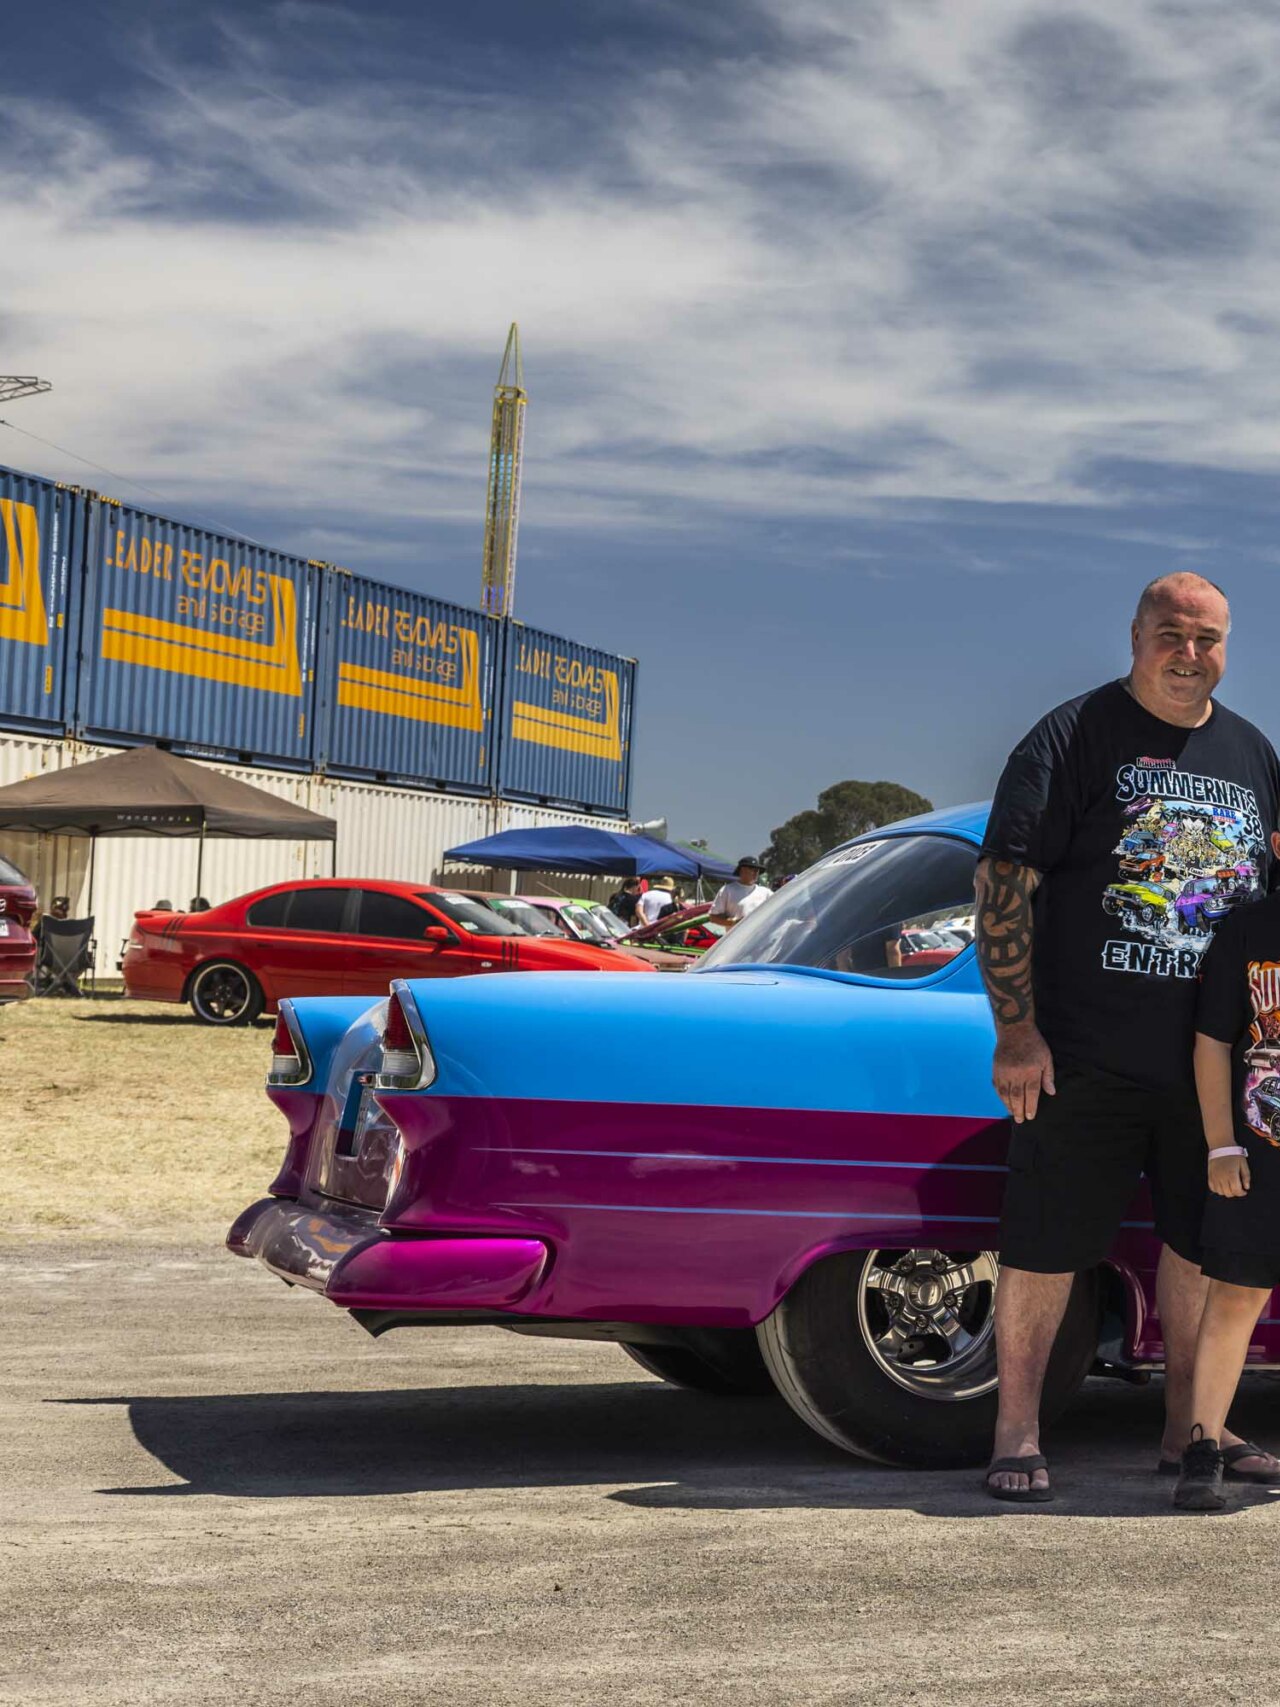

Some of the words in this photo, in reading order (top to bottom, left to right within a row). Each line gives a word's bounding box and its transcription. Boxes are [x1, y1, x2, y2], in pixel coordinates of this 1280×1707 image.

[1115, 763, 1260, 818] SUMMERNATS
[1212, 807, 1237, 820] RARE
[1243, 812, 1265, 840] 38
[1101, 940, 1205, 979] ENTR
